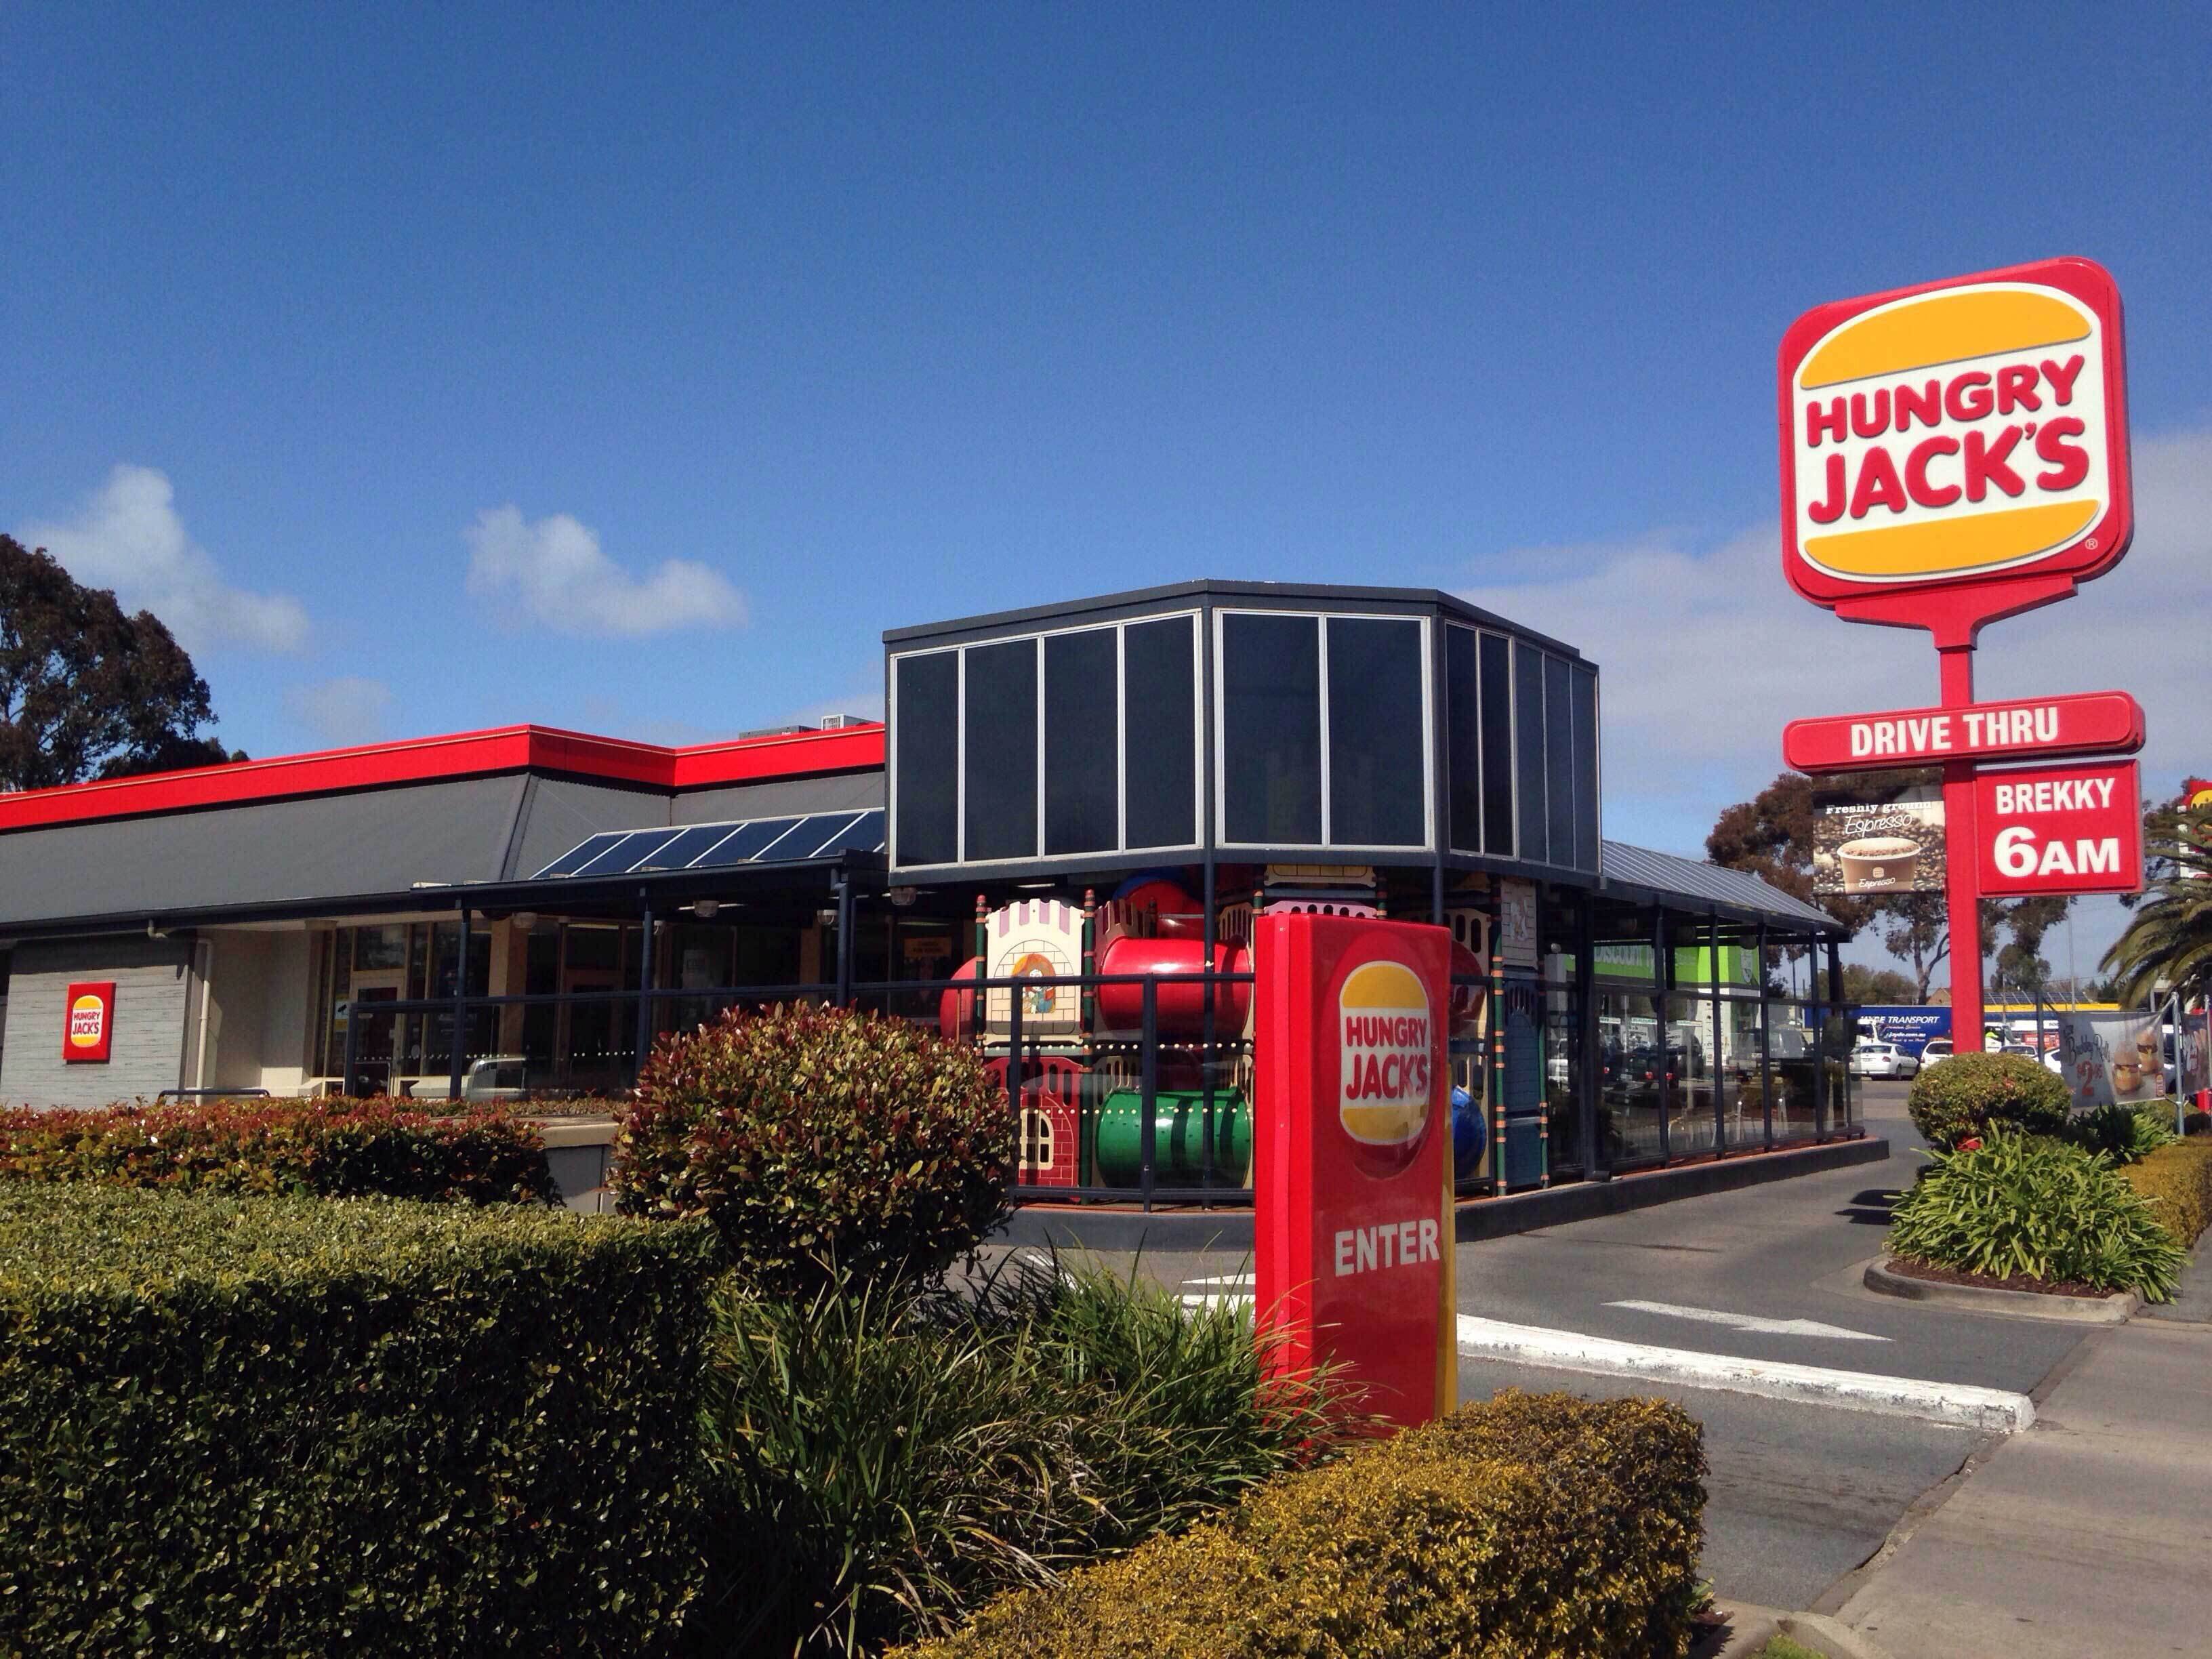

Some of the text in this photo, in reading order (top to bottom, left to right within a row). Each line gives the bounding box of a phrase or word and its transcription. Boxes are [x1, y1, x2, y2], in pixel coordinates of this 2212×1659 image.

[1806, 354, 2085, 447] HUNGRY
[1808, 416, 2090, 525] JACK'S
[1851, 706, 2058, 757] DRIVE THRU
[1826, 803, 1879, 815] Freshly
[1995, 777, 2115, 815] BREKKY
[1845, 814, 1912, 838] Espresso
[1994, 826, 2121, 878] 6AM
[1859, 877, 1896, 889] Espresso
[73, 1011, 100, 1021] HUNGRY
[1346, 1016, 1427, 1048] HUNGRY
[1888, 1016, 1940, 1024] TRANSPORT
[1346, 1052, 1428, 1101] JACK'S
[1335, 1218, 1440, 1277] ENTER
